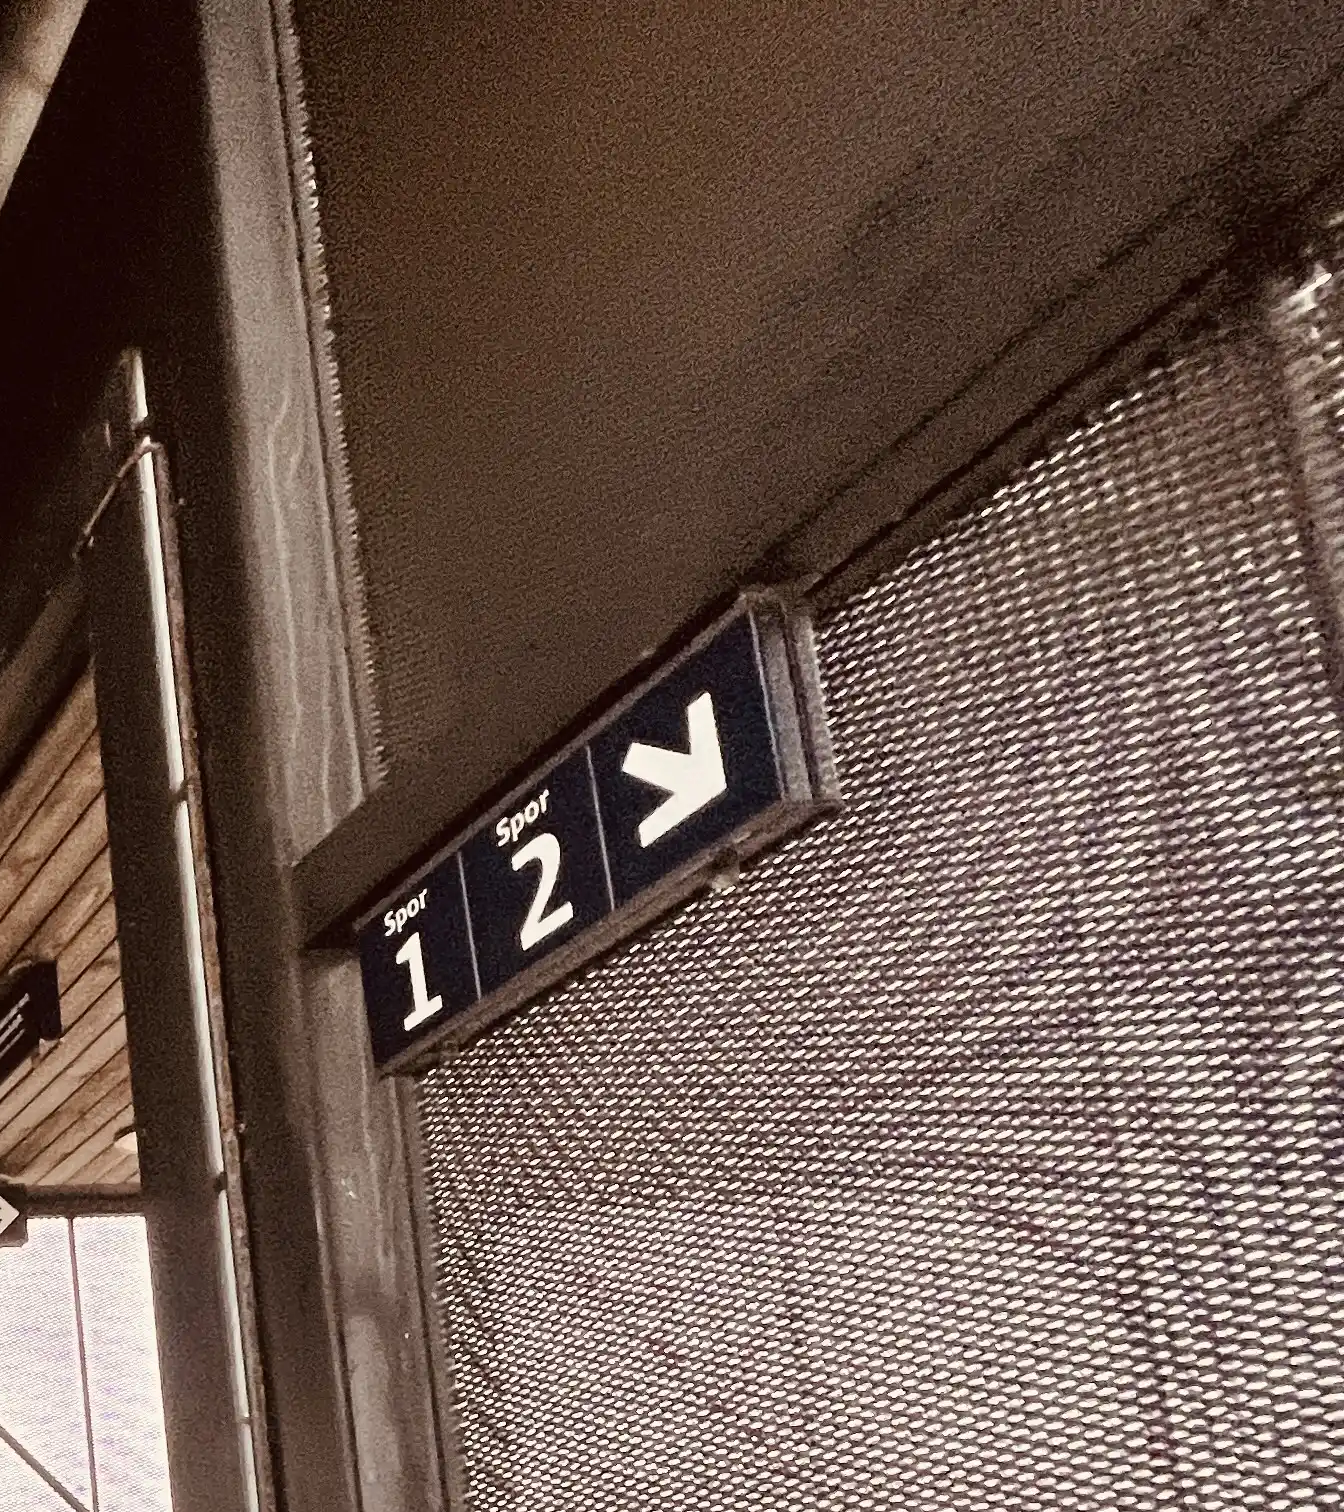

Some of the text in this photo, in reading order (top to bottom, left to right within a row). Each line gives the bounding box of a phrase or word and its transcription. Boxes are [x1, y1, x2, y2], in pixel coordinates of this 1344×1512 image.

[496, 789, 550, 847] Spor
[383, 889, 428, 937] Spor
[511, 832, 574, 951] 2
[395, 932, 443, 1032] 1
